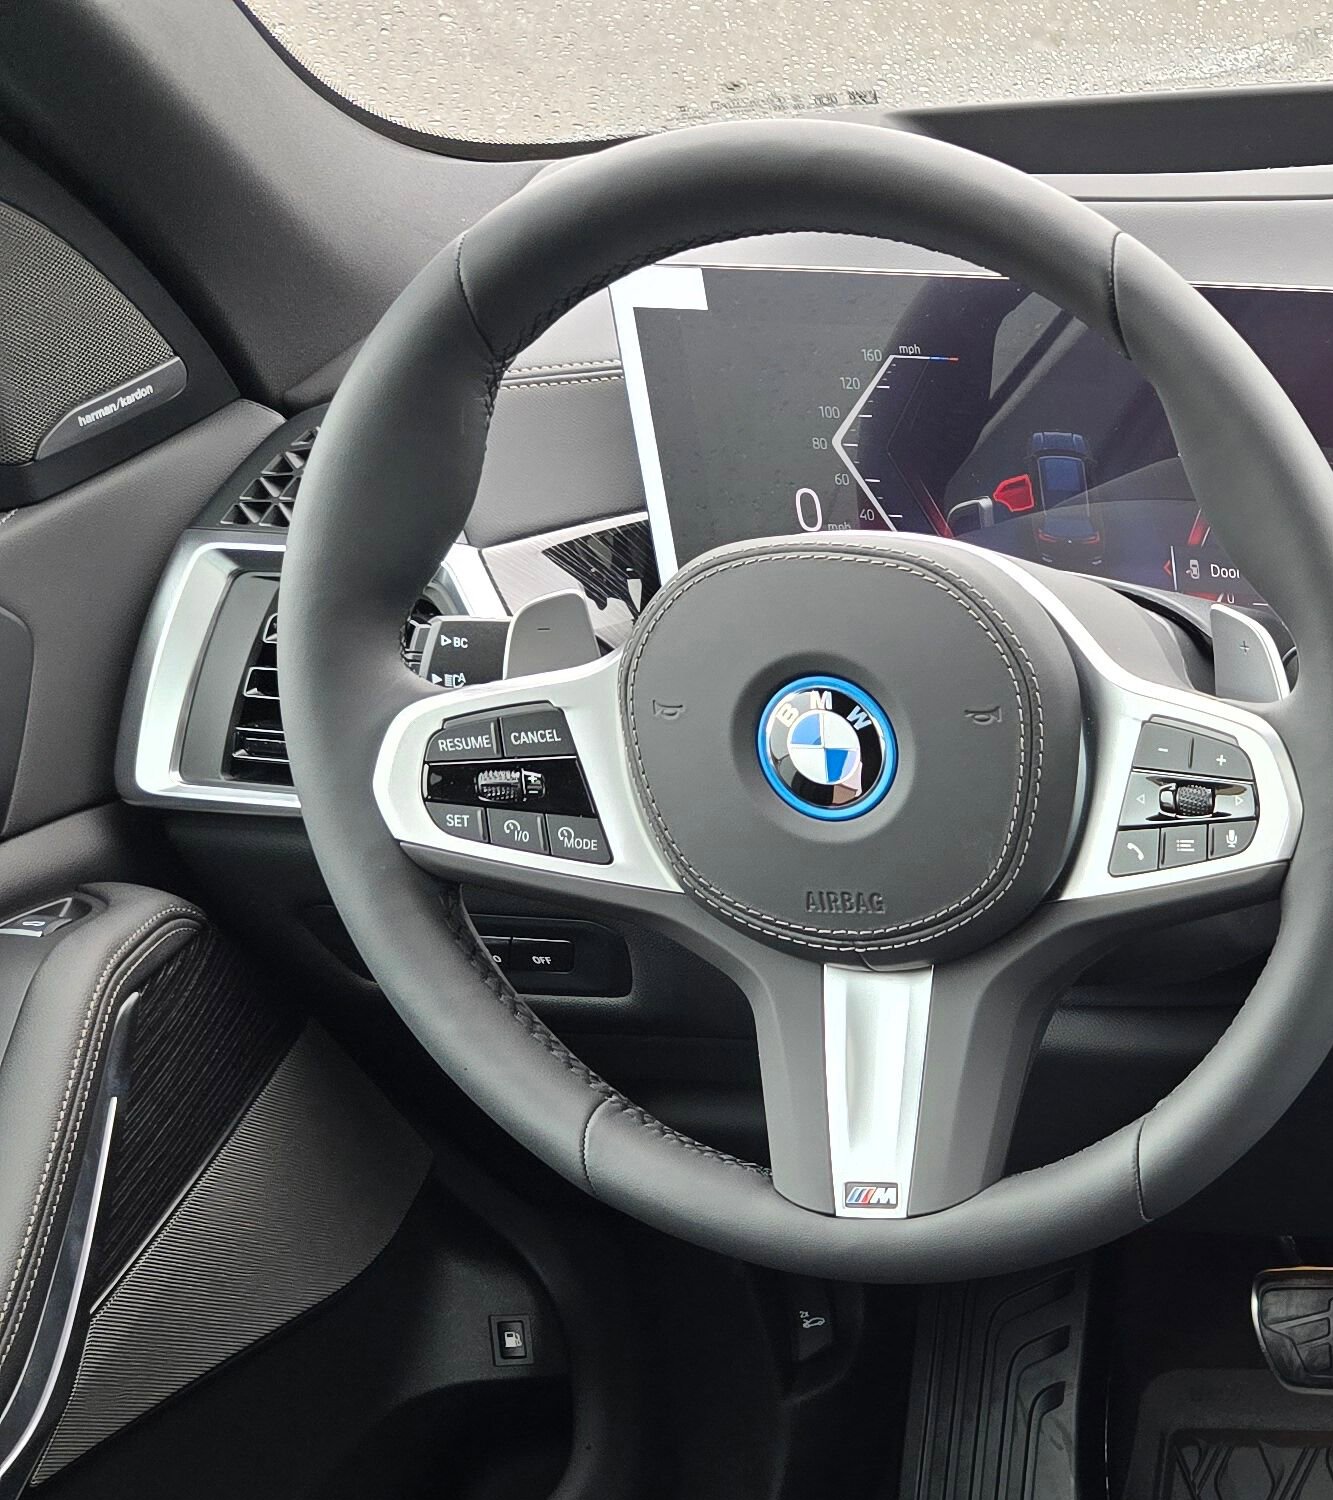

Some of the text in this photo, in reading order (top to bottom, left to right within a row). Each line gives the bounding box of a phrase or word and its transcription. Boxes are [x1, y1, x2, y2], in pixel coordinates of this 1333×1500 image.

[861, 349, 883, 362] 160
[899, 344, 921, 355] mph
[840, 377, 860, 390] 120
[78, 385, 153, 426] harman/kardon
[818, 406, 840, 419] 100
[812, 437, 828, 450] 80
[834, 473, 850, 485] 60
[795, 488, 823, 532] 0
[859, 509, 875, 521] 40
[453, 637, 468, 649] BC
[776, 690, 872, 731] BMW
[438, 735, 492, 752] RESUME
[510, 729, 562, 745] CANCEL
[446, 814, 470, 827] SET
[514, 830, 530, 842] I/O
[563, 837, 598, 851] MODE
[806, 891, 886, 914] AIRBAG
[532, 956, 552, 965] OFF
